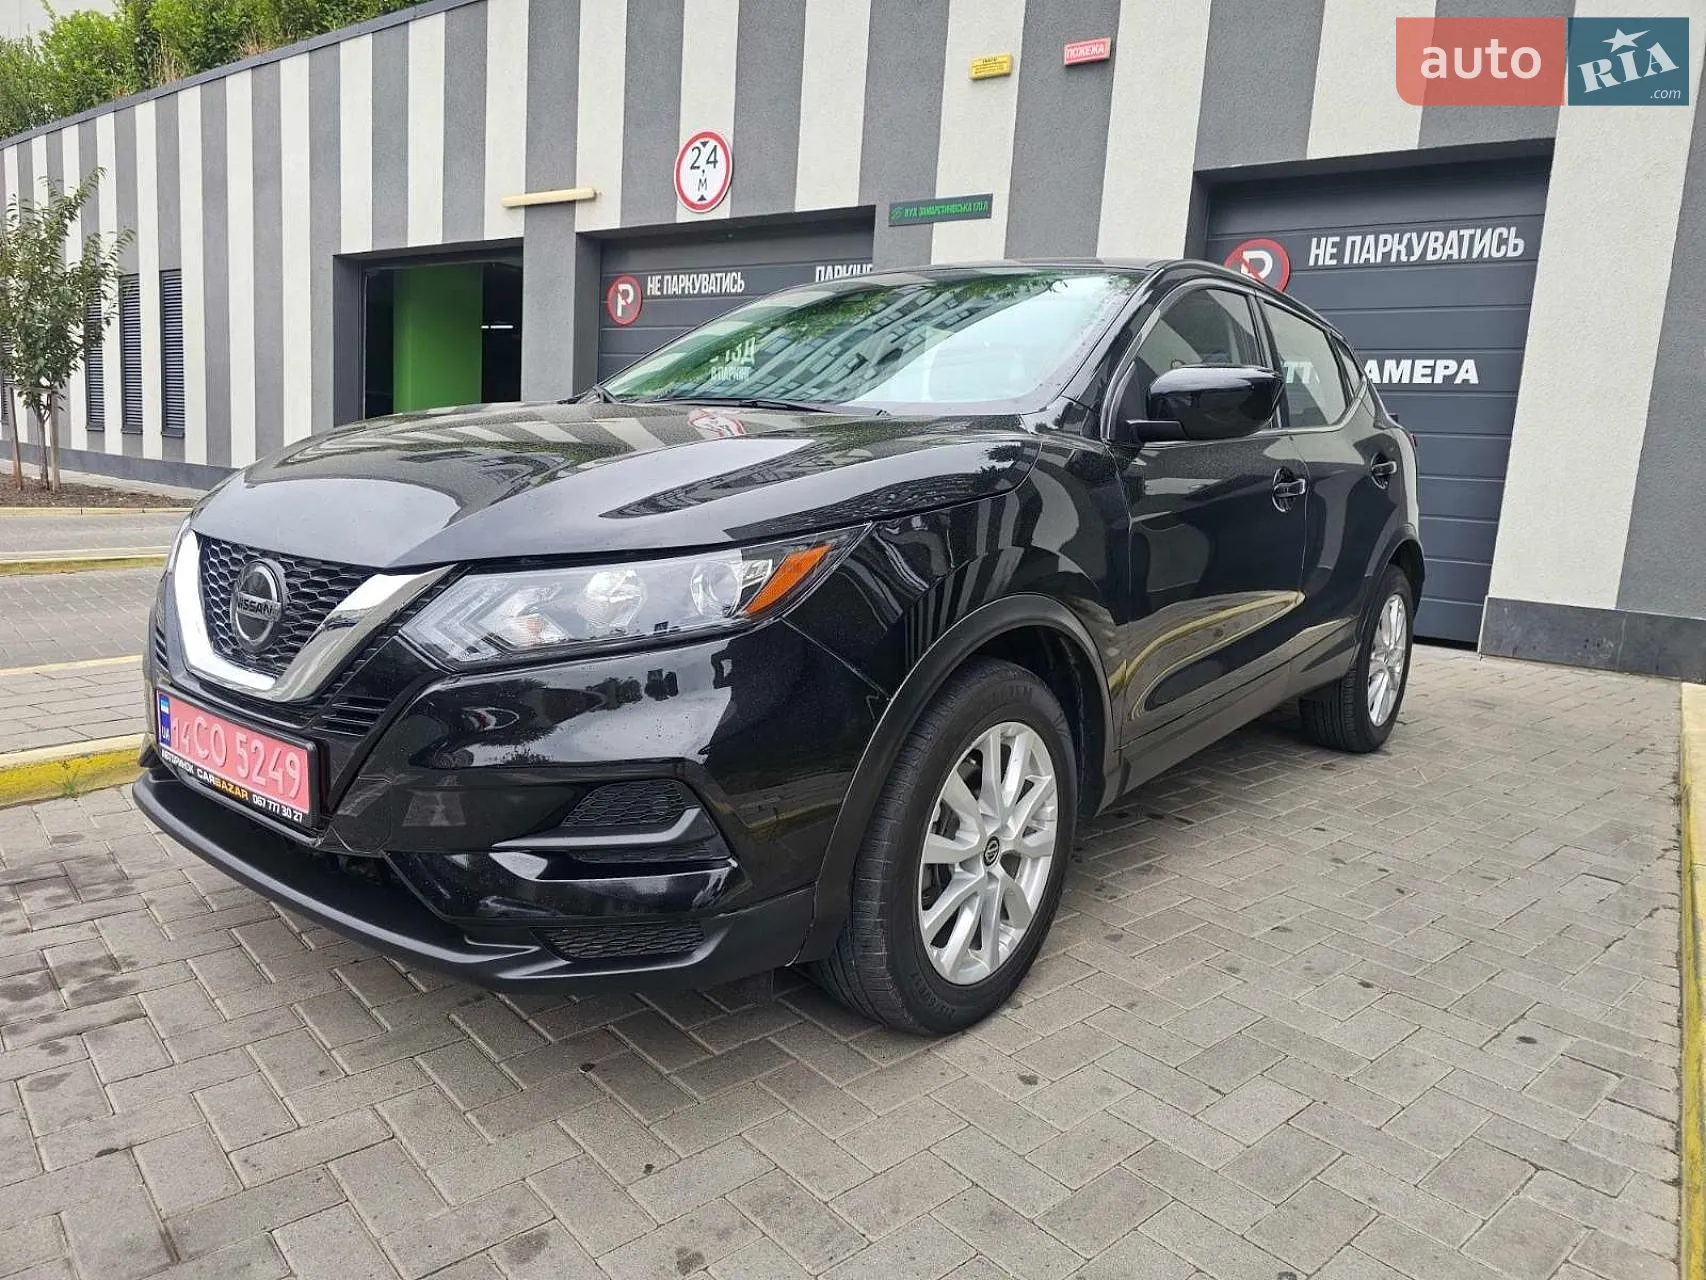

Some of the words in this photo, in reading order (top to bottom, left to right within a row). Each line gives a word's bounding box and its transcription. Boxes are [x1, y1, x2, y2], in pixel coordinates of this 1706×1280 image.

[1309, 235, 1340, 266] НЕ
[1343, 226, 1525, 264] ПАРКУВАТИСЬ
[647, 276, 661, 295] НЕ
[663, 272, 745, 295] ПАРКУВАТИСЬ
[235, 732, 301, 800] 5249
[252, 794, 266, 808] 067
[281, 804, 292, 818] 30
[292, 811, 303, 823] 27
